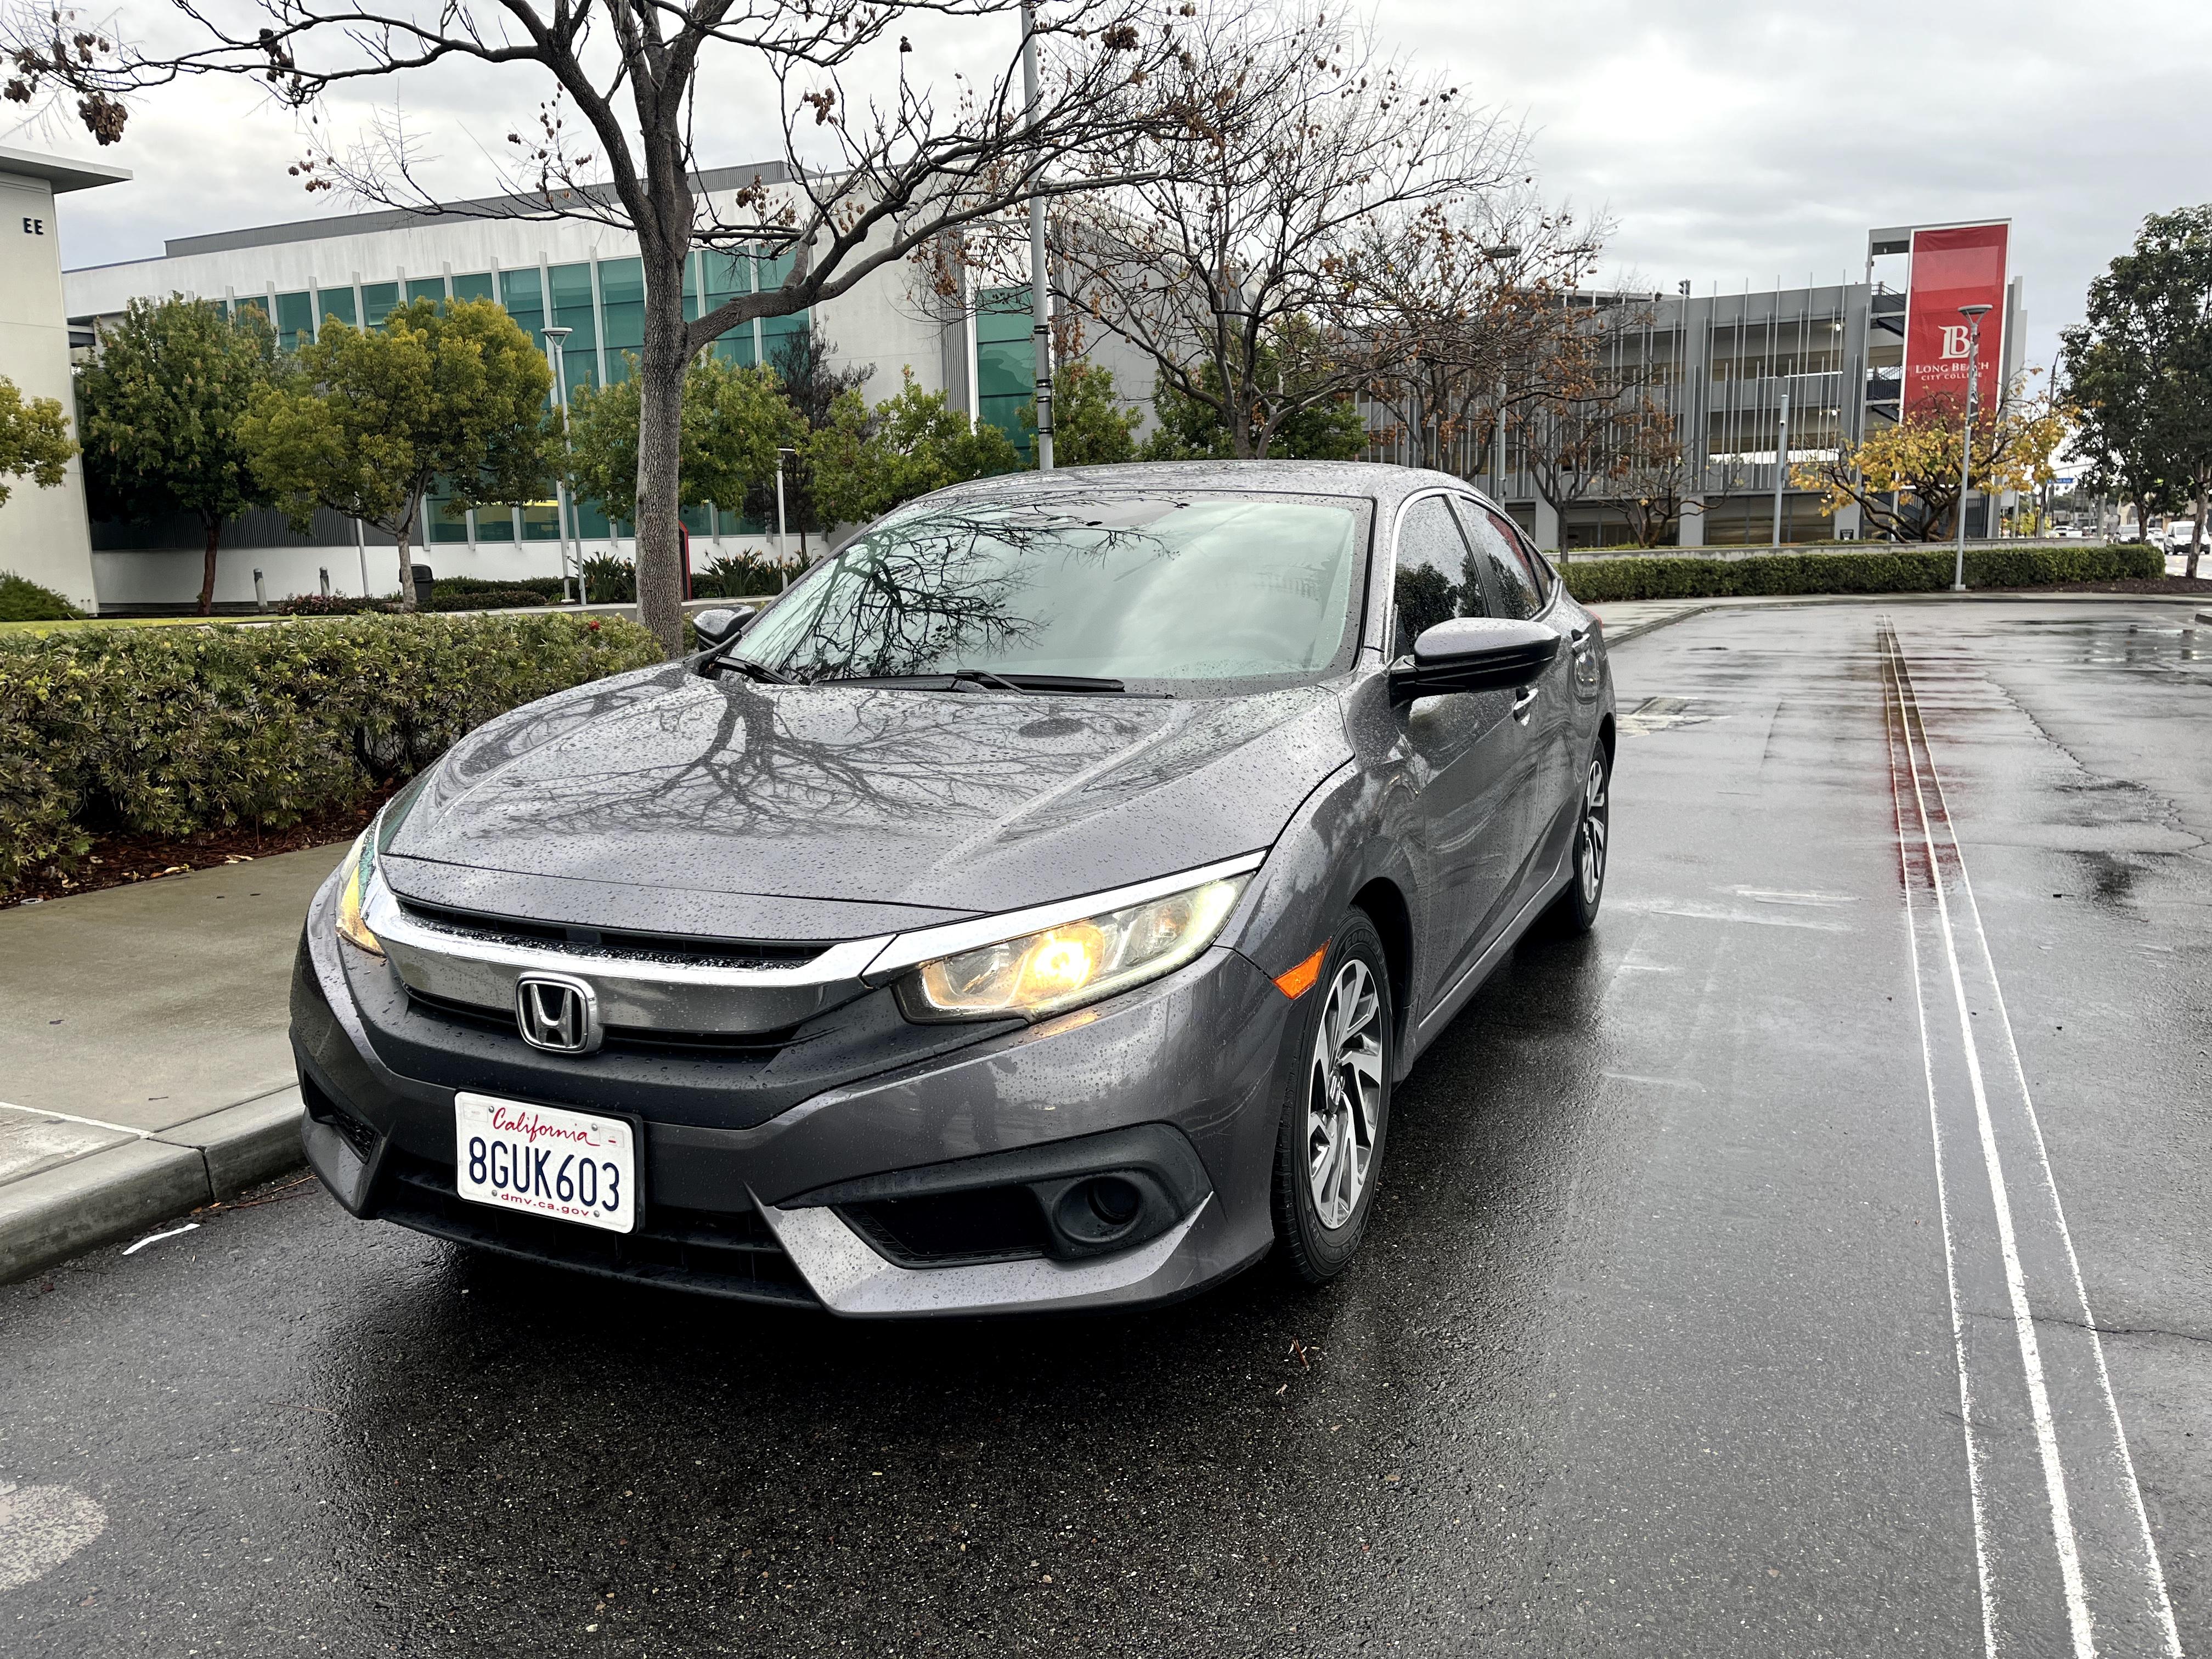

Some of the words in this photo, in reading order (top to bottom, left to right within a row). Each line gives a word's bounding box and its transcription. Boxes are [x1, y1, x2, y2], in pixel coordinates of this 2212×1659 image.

[22, 217, 44, 235] EE
[1915, 364, 1948, 374] LONG
[1952, 362, 1989, 371] BEAH
[493, 1107, 601, 1147] California
[469, 1136, 620, 1211] 8GUK603
[501, 1193, 590, 1217] dmv.ca.gov
